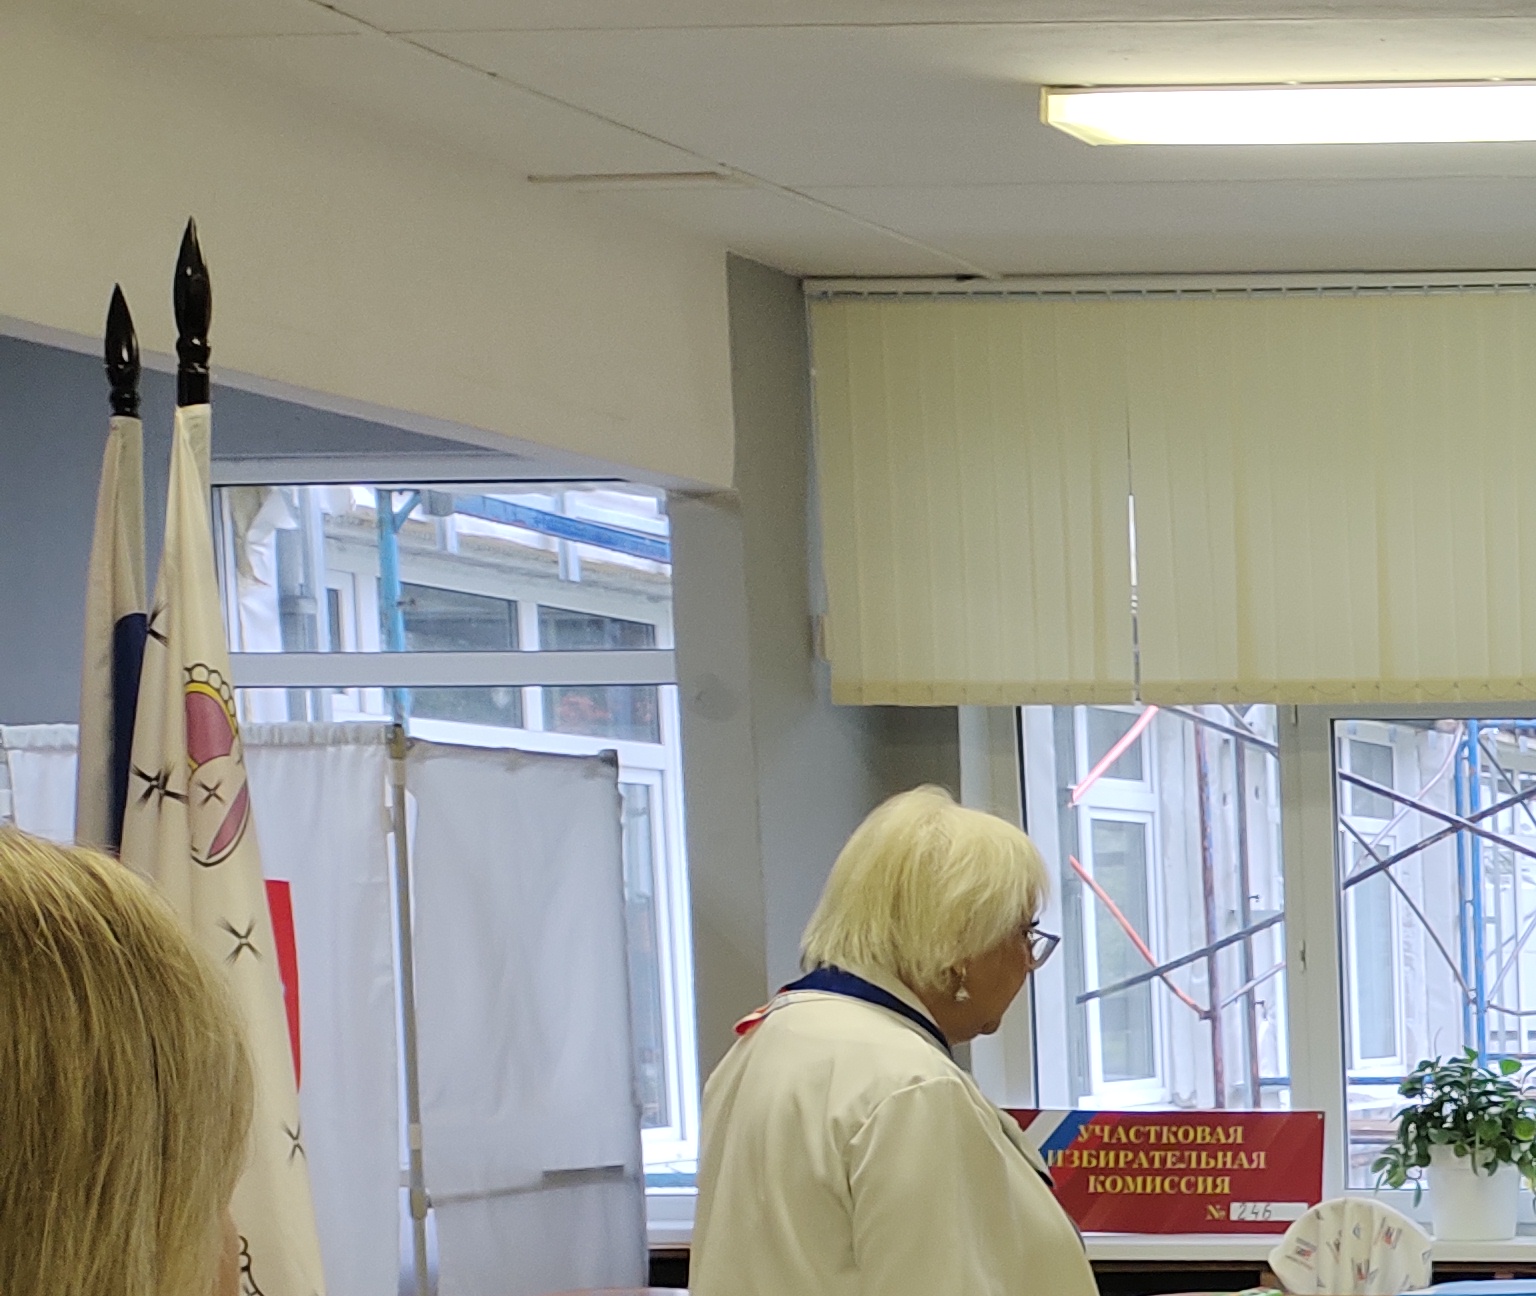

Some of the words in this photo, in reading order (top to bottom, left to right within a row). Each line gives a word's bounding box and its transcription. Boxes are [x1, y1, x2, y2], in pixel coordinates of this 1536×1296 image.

[1077, 1124, 1244, 1145] УЧАСТКОВАЯ
[1047, 1150, 1266, 1169] ИЗБИРАТЕЛЬНАЯ
[1087, 1174, 1231, 1195] КОМИССИЯ
[1237, 1203, 1272, 1221] 246
